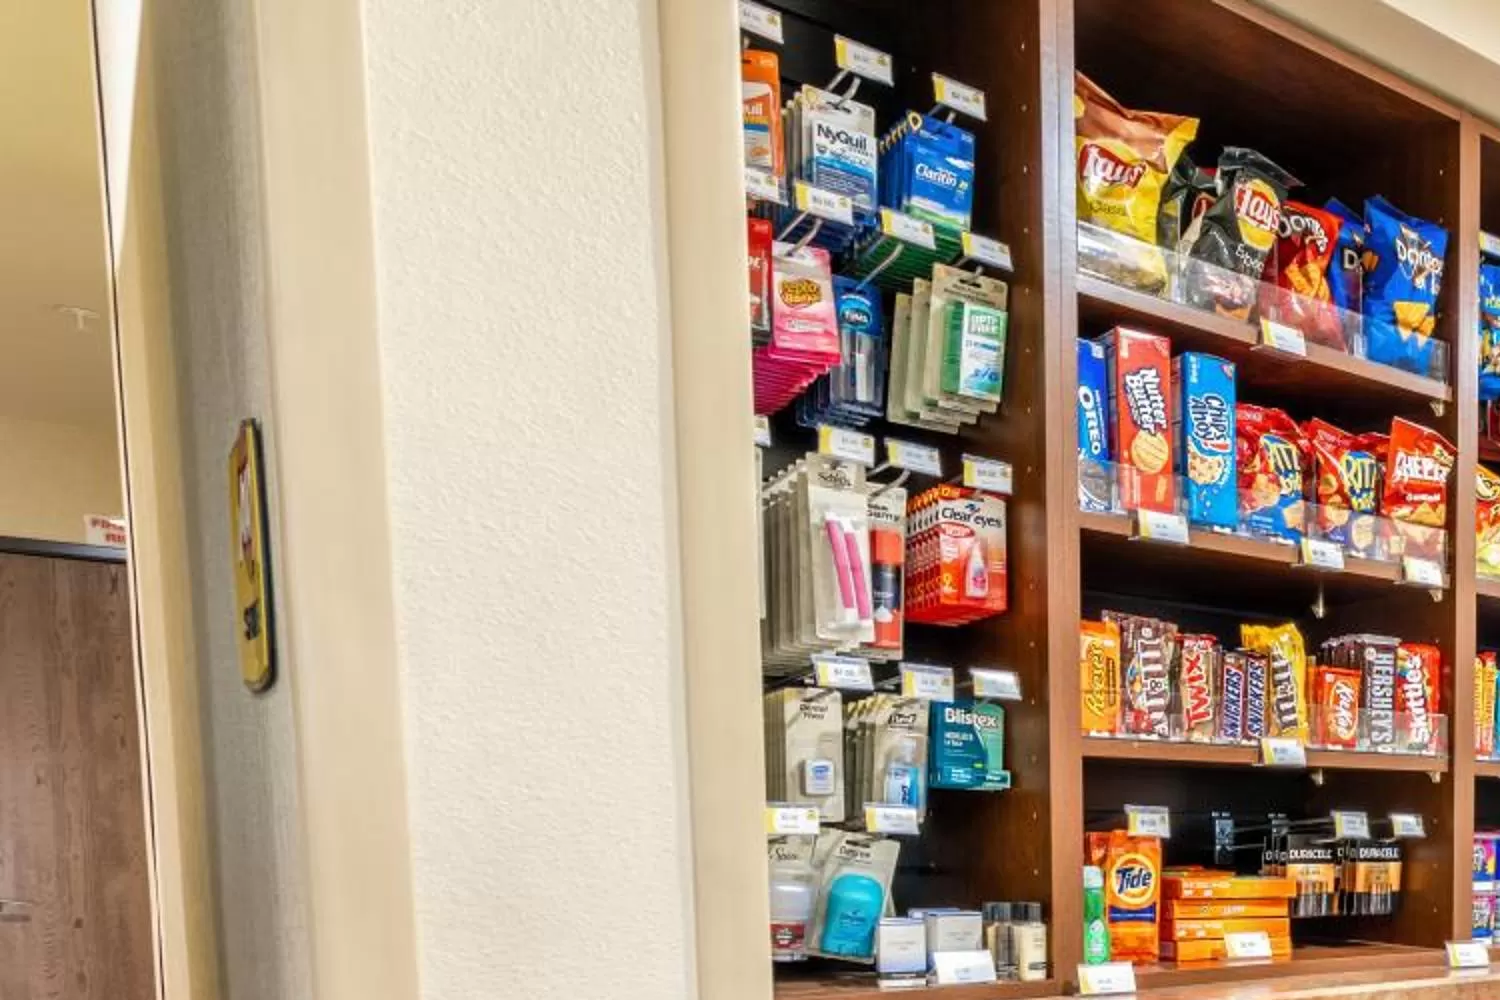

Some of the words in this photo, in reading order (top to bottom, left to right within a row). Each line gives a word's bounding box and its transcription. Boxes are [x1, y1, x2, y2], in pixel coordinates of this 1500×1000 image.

[816, 123, 868, 151] NyQuil
[915, 163, 957, 187] Claritin
[1078, 386, 1101, 455] OREO
[1126, 374, 1156, 436] Butter
[1139, 367, 1168, 431] Nutter
[941, 507, 972, 521] Clear
[974, 514, 1002, 530] eyes
[944, 706, 999, 728] Blistex
[1223, 667, 1244, 739] SNICKERS
[1247, 660, 1267, 737] SNICKERS
[1406, 655, 1431, 744] Skittles
[1289, 847, 1333, 860] DURACELL
[1115, 866, 1152, 894] Tide
